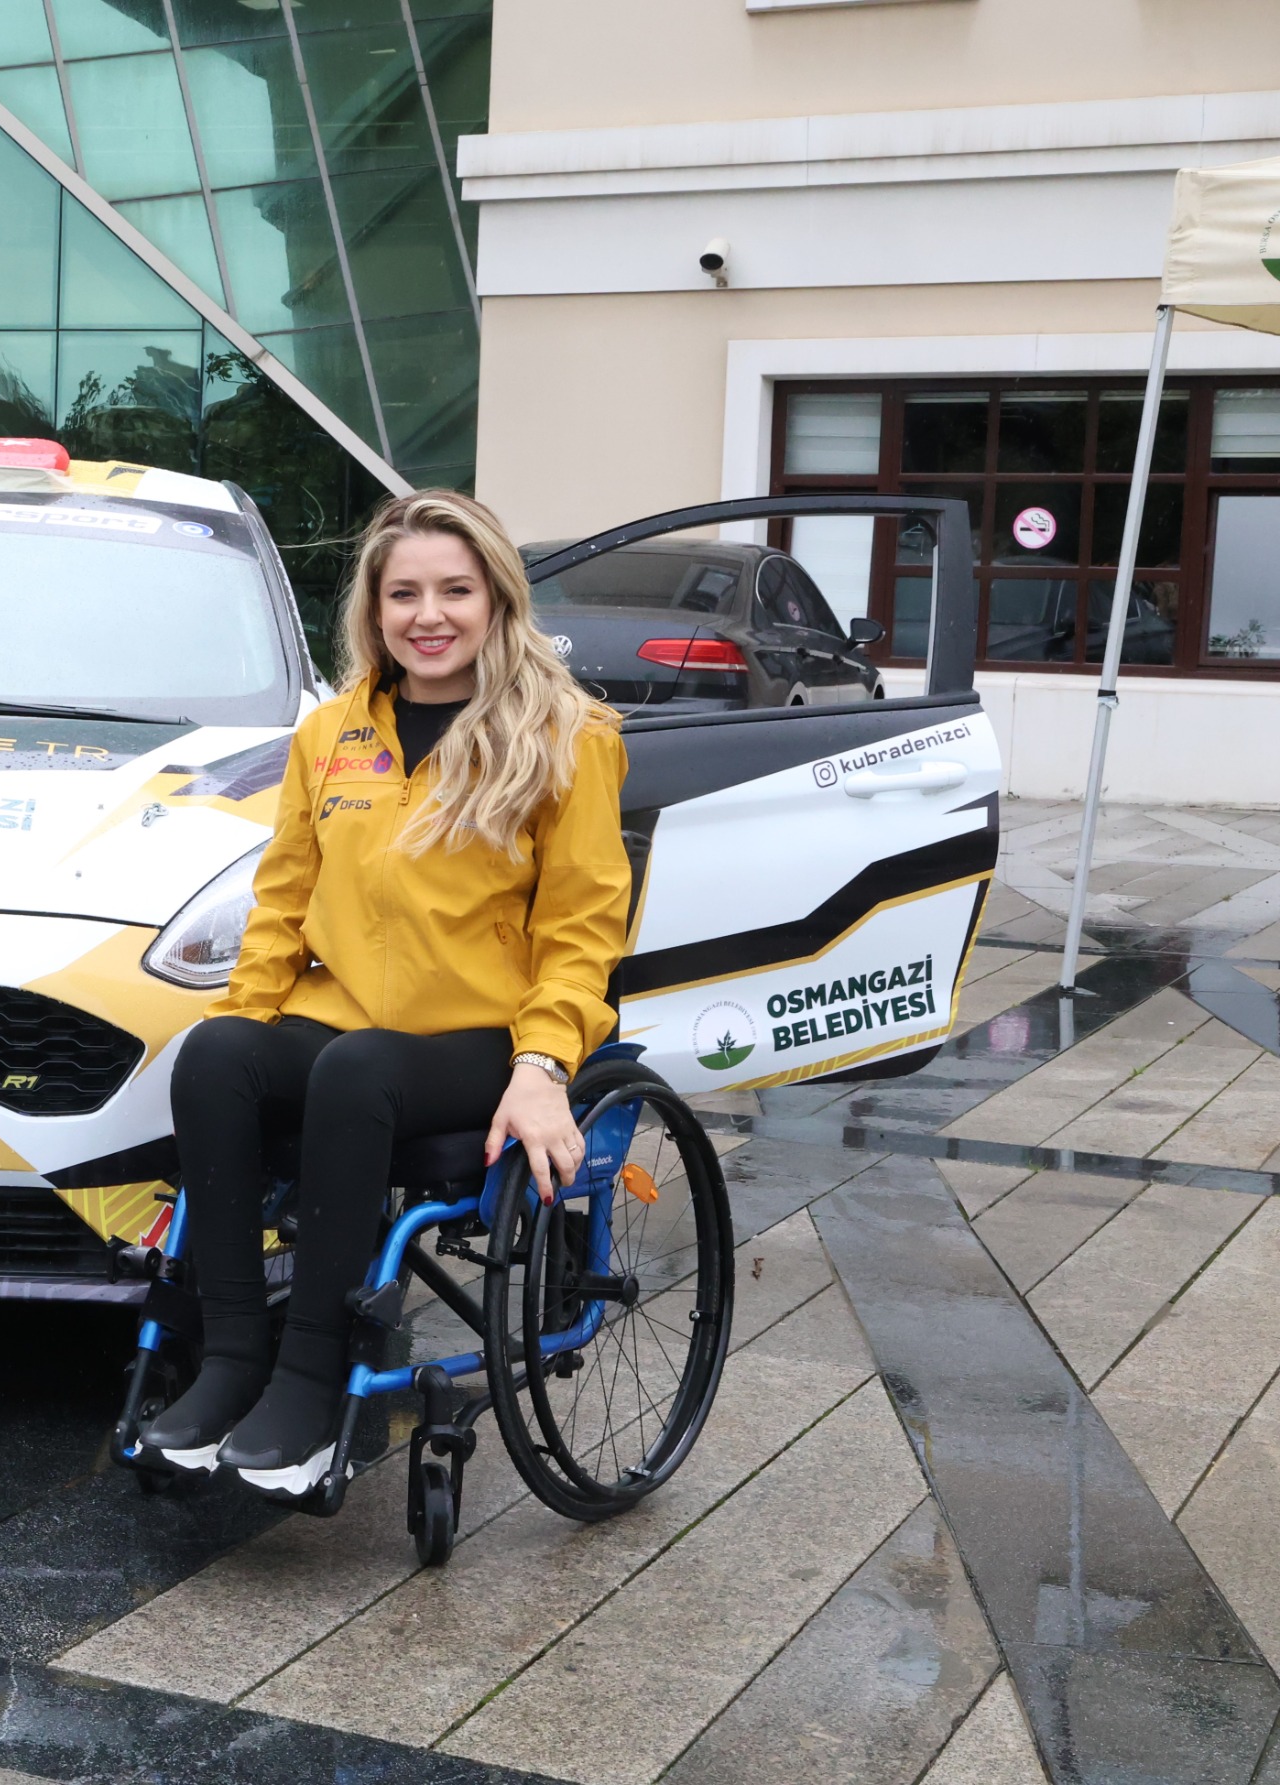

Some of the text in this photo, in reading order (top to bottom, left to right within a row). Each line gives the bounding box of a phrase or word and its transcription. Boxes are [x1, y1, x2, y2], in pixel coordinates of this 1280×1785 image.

[36, 741, 113, 763] TR
[839, 723, 972, 773] kubradenizci
[339, 799, 372, 811] DFDS
[767, 954, 933, 1019] OSMANGAZİ
[772, 983, 936, 1052] BELEDİYESİ
[2, 1075, 39, 1089] R1
